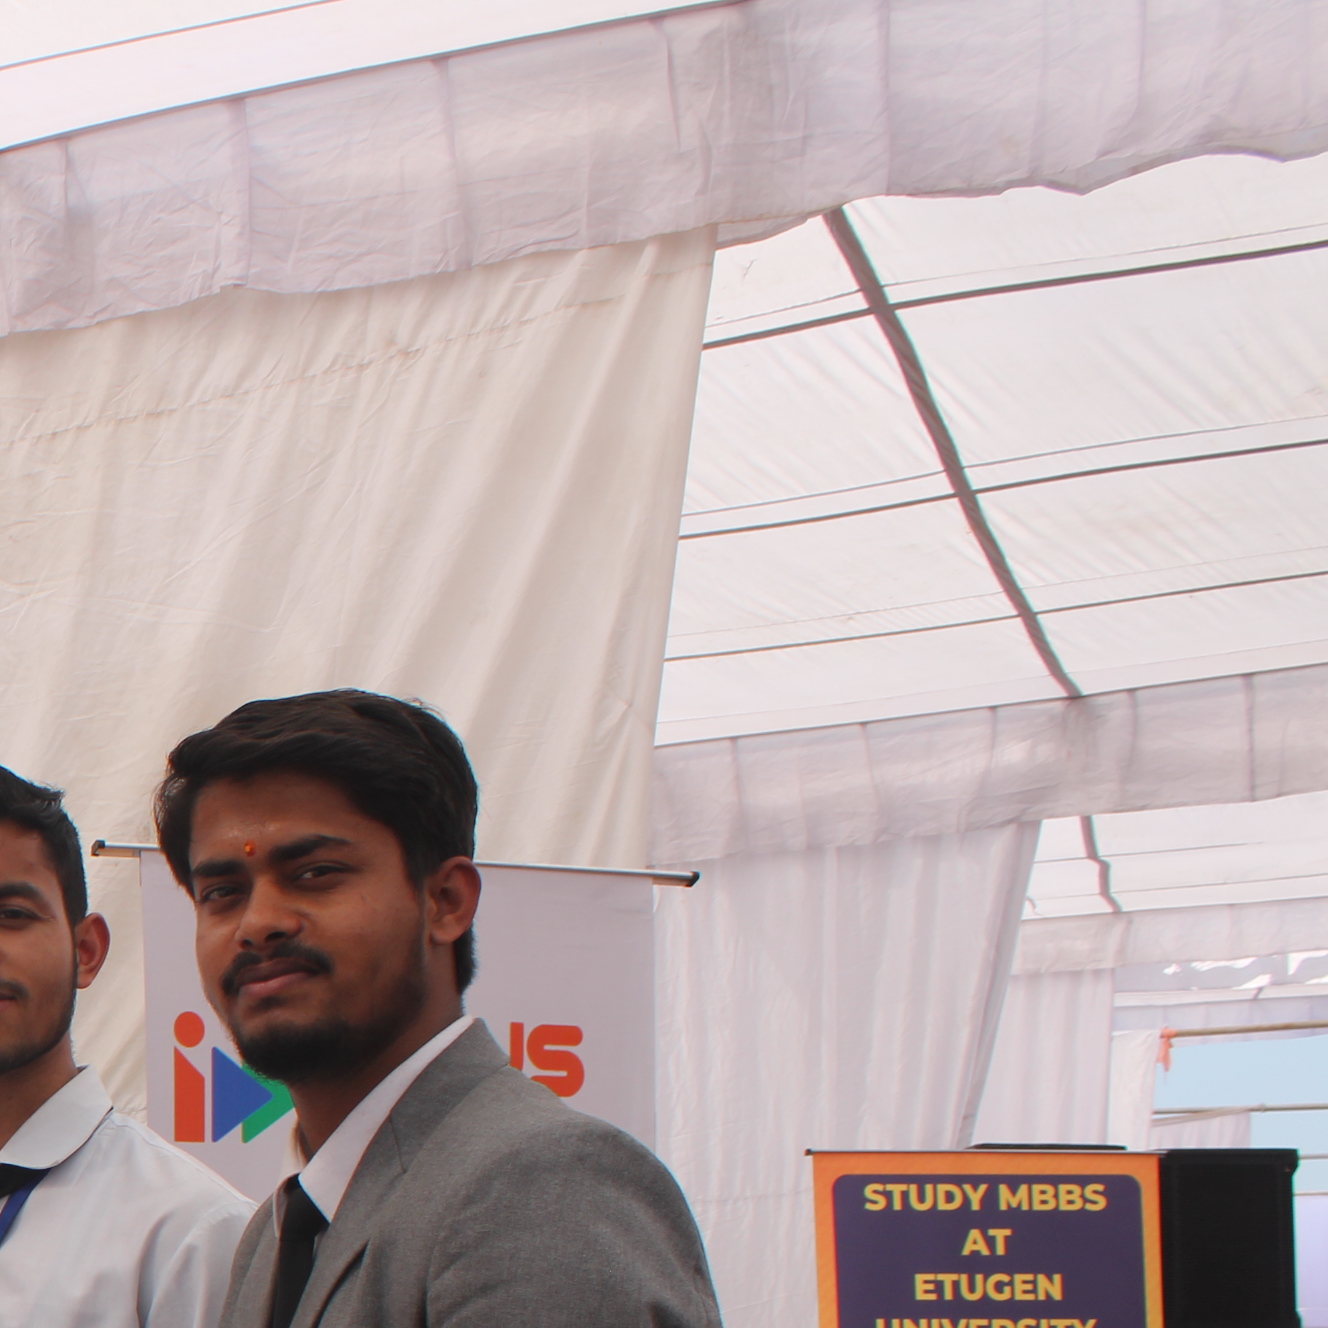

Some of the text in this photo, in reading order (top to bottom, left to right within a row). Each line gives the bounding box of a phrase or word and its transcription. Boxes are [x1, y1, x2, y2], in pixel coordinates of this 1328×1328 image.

[863, 1183, 1108, 1211] STUDY MBBS
[961, 1228, 1012, 1256] AT
[914, 1273, 1062, 1301] ETUGEN
